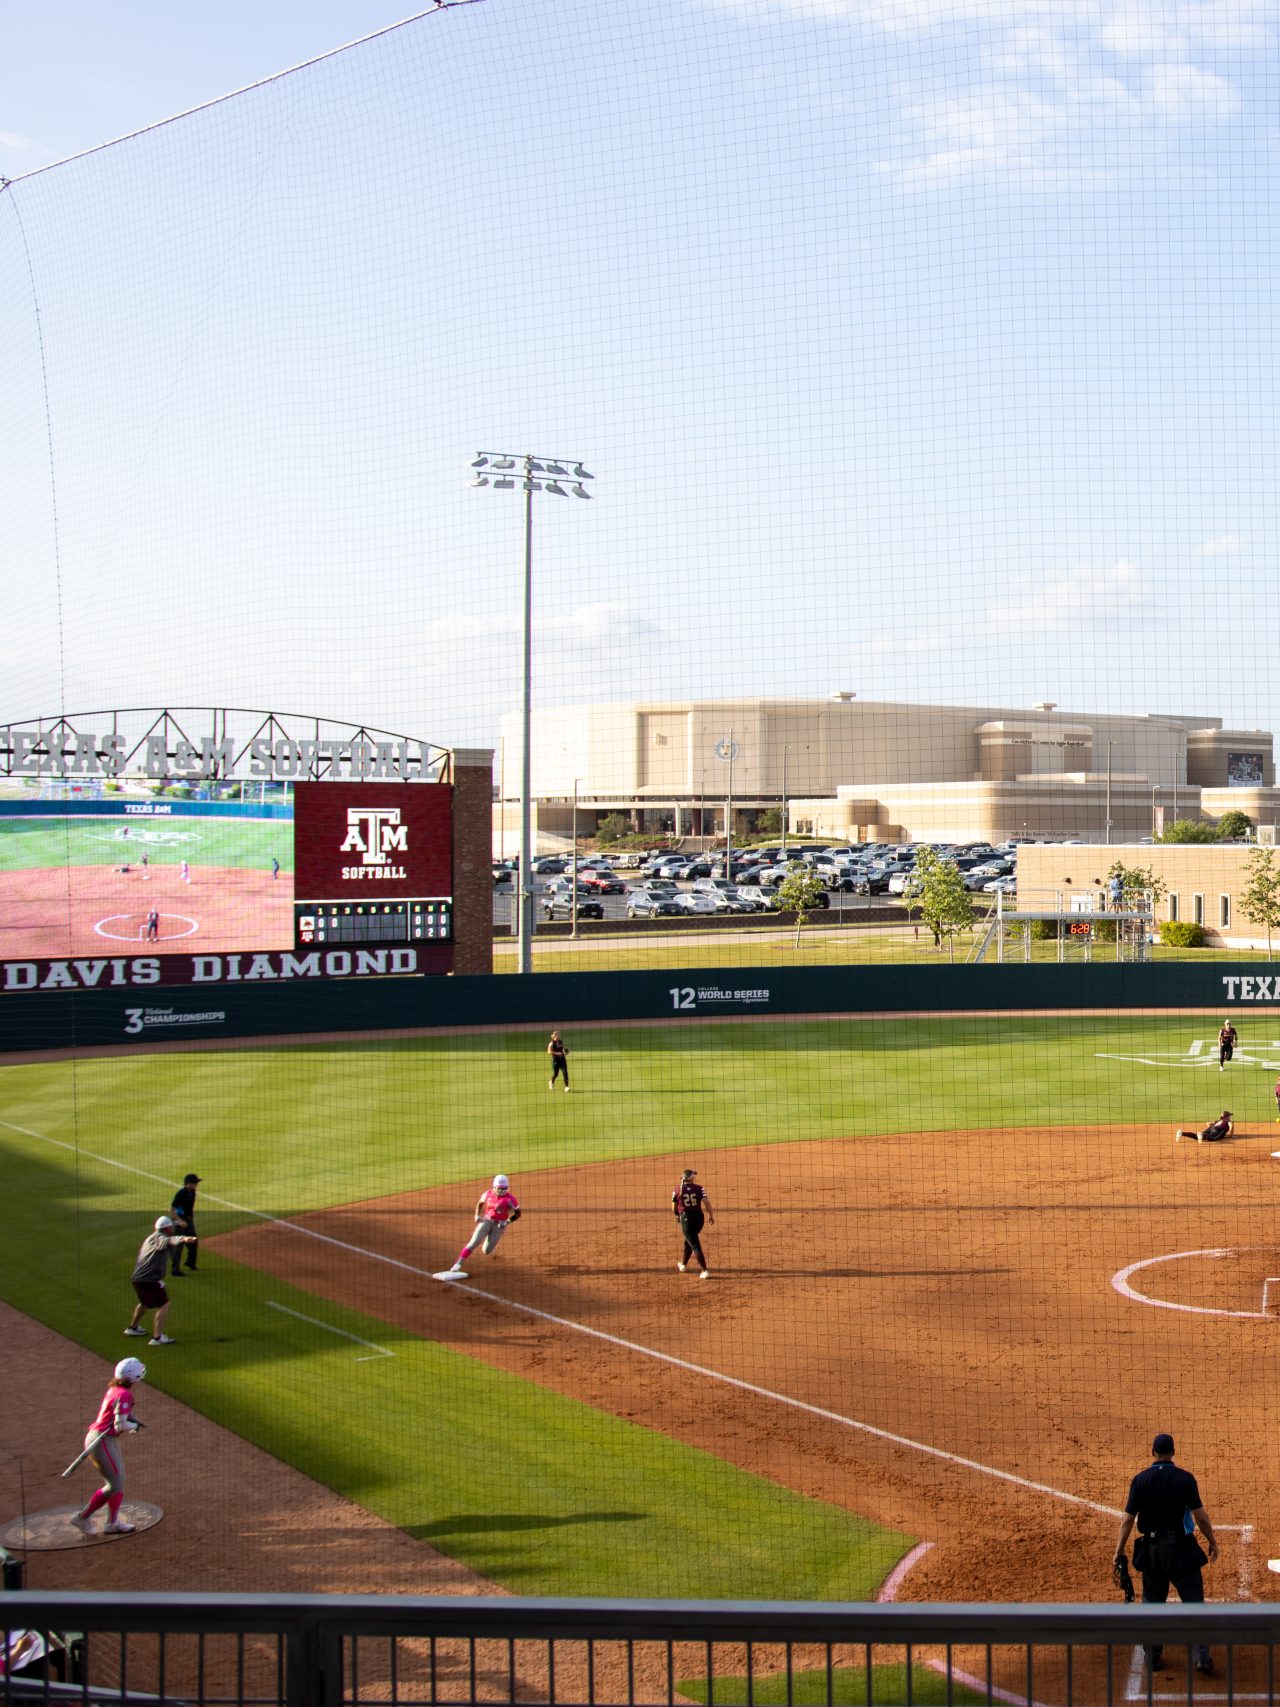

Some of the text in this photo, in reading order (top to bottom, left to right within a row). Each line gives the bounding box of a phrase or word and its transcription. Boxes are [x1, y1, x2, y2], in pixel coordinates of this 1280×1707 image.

[144, 736, 235, 776] A&M
[250, 739, 440, 778] SOFTBALL
[125, 805, 153, 813] TEXAS
[341, 866, 407, 879] SOFTBALL
[318, 915, 447, 928] 0 0 0 0 0
[318, 931, 325, 941] 0
[415, 928, 422, 938] 0
[428, 928, 434, 937] 2
[441, 927, 447, 937] 0
[1071, 923, 1090, 934] 6:28
[3, 948, 418, 990] DAVIS DIAMOND
[669, 987, 696, 1009] 12
[698, 989, 770, 999] WORLD SERIES
[124, 1008, 144, 1034] 3
[144, 1011, 225, 1024] CHAMPIONSHIPS
[683, 1193, 698, 1207] 26
